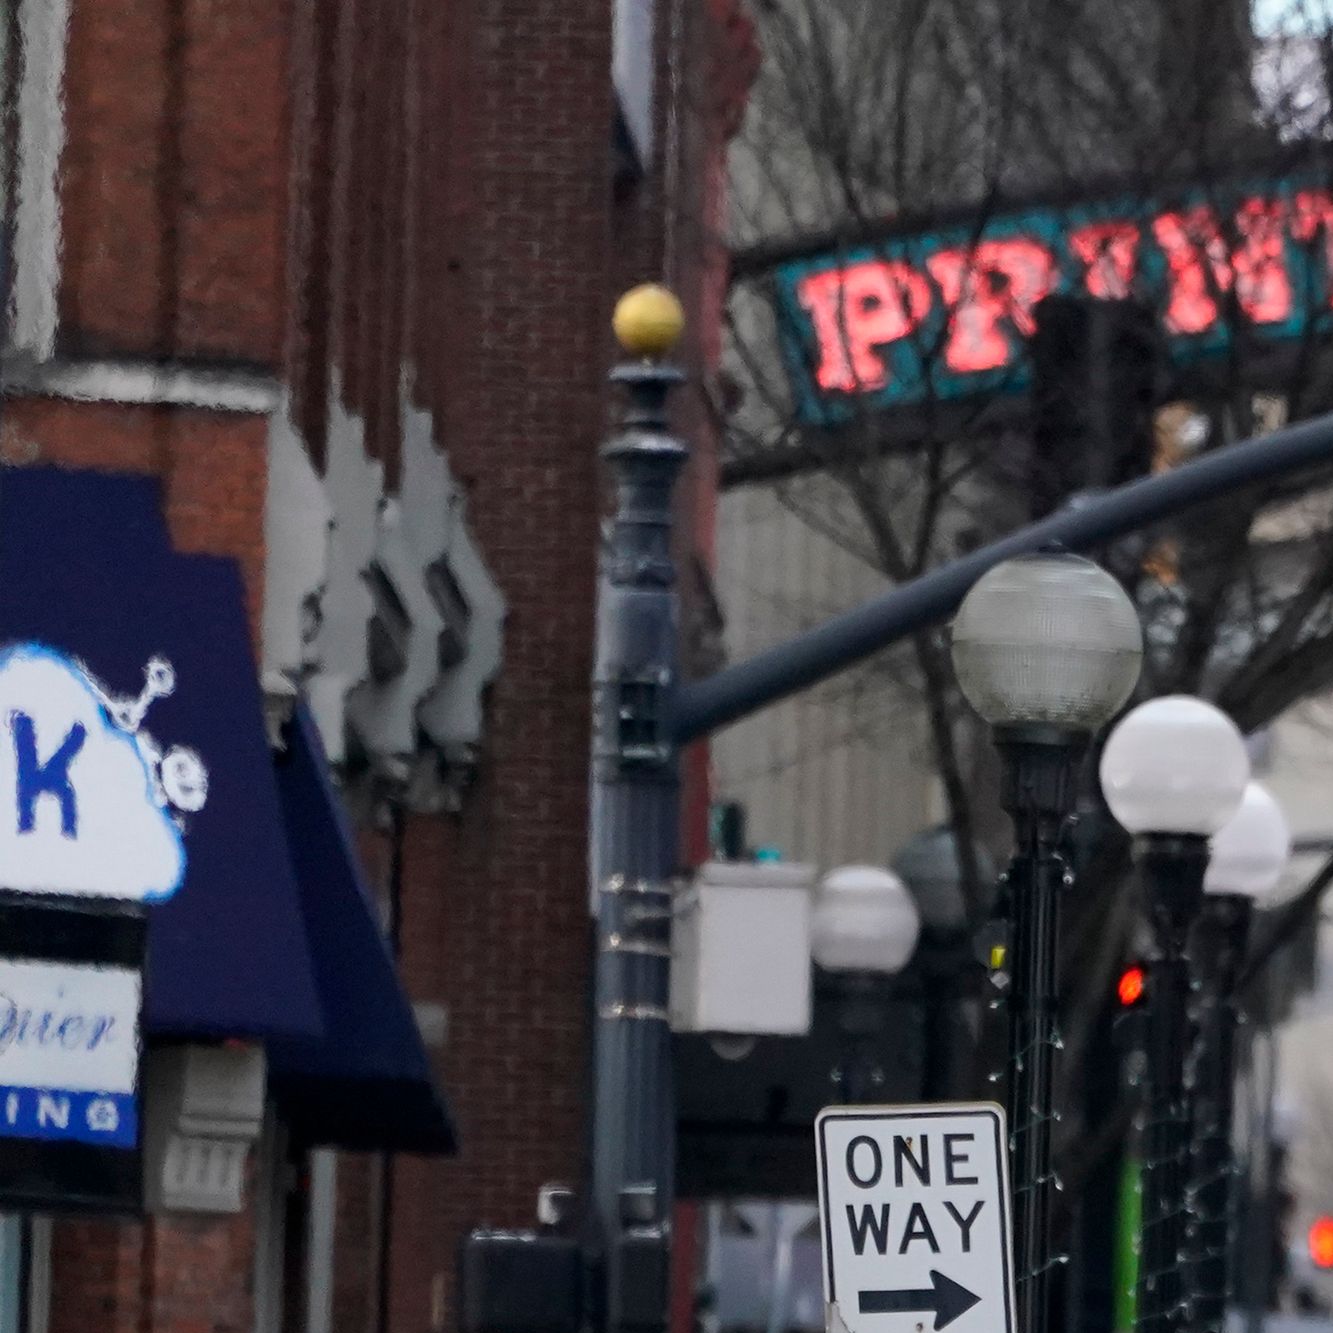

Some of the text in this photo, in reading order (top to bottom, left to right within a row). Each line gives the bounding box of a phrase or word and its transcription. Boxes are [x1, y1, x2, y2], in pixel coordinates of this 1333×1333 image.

[13, 709, 87, 841] K
[846, 1133, 979, 1189] ONE
[846, 1200, 985, 1256] WAY
